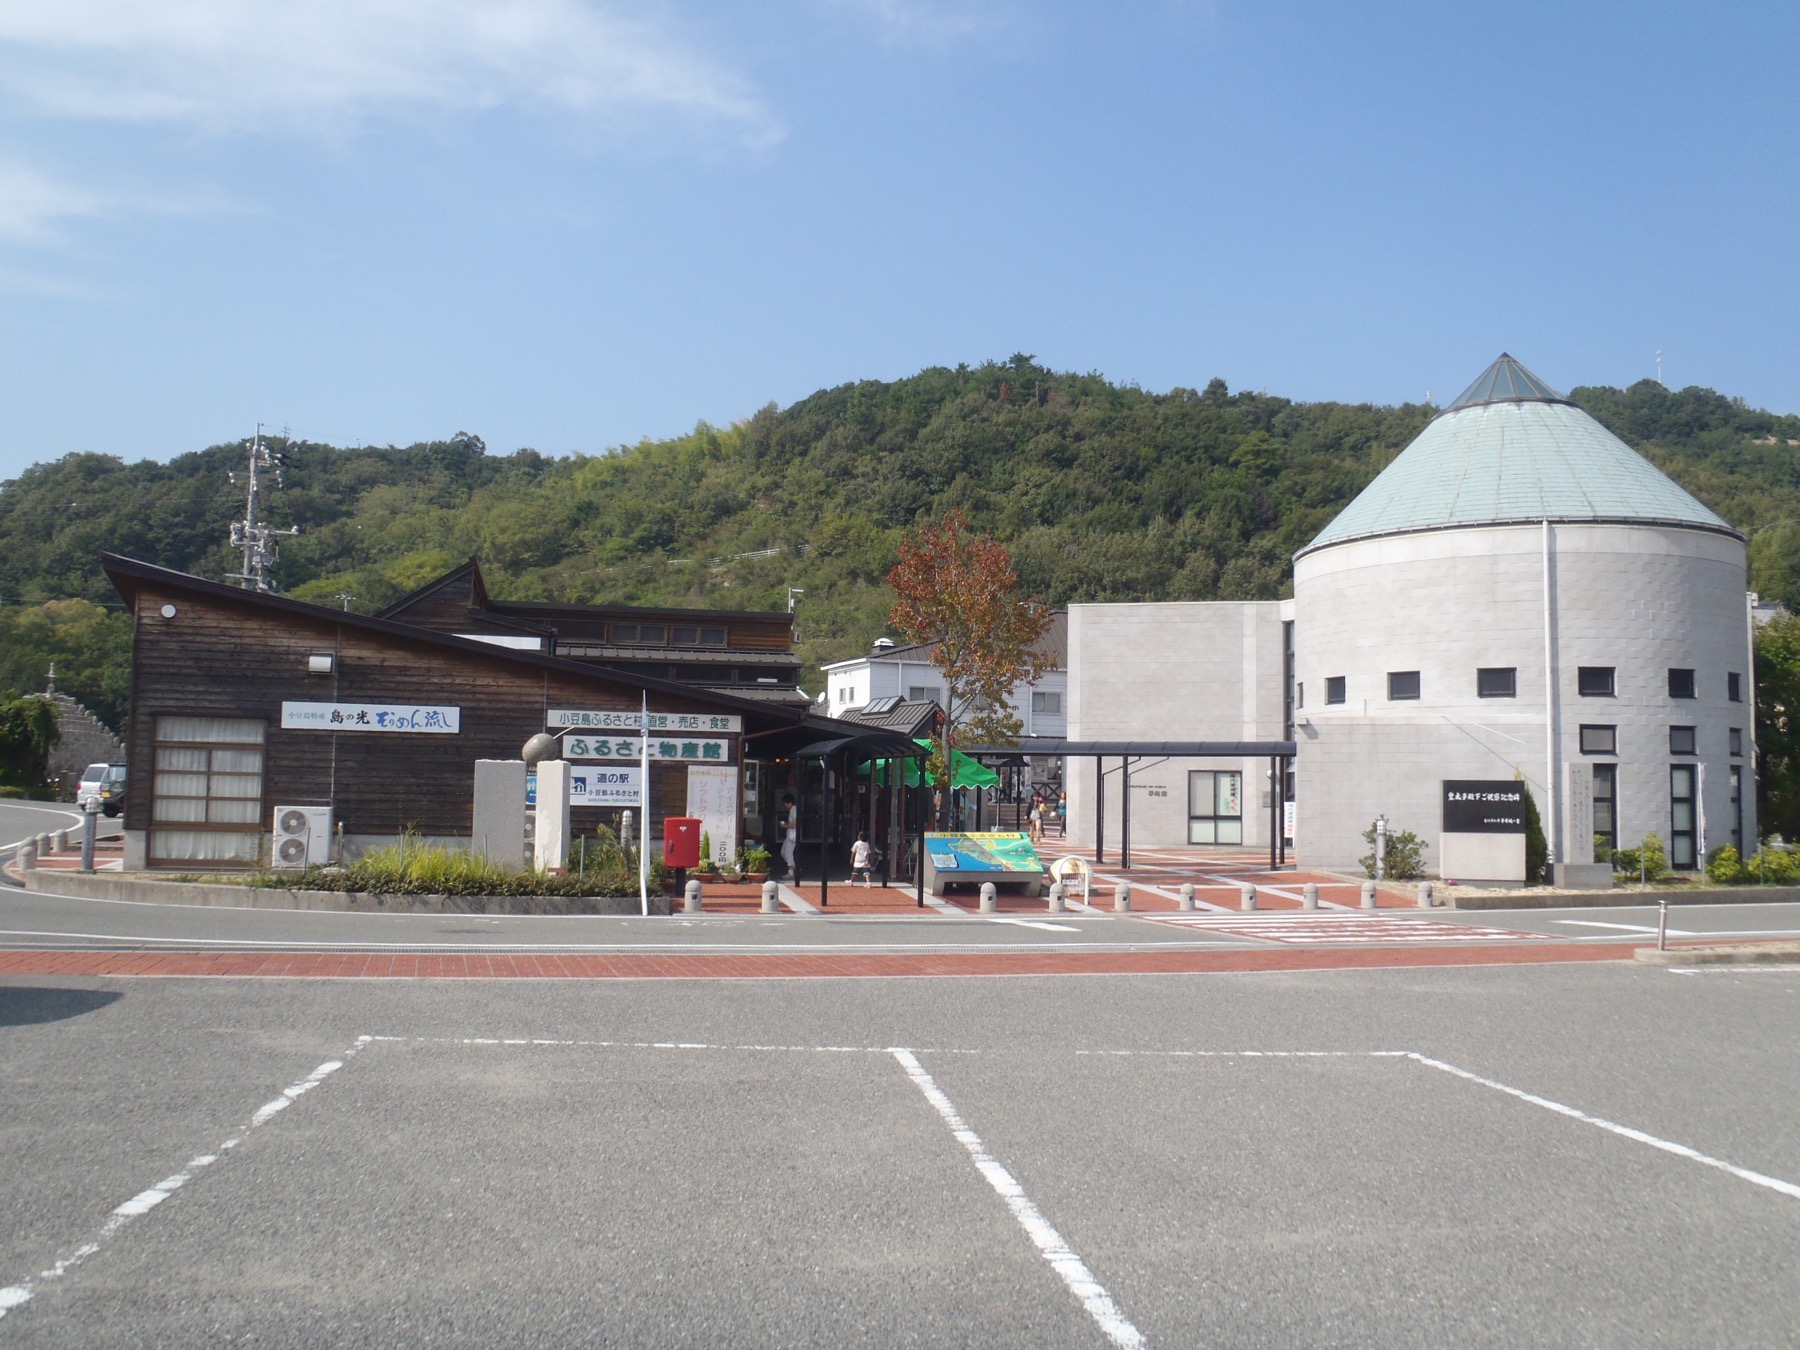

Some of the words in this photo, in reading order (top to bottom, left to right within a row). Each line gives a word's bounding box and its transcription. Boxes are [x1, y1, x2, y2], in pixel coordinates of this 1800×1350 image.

[330, 709, 371, 725] 島の光
[570, 738, 722, 759] ふるさと物産館
[597, 773, 629, 784] 道の駅
[588, 789, 640, 797] 小豆島ふるさと村
